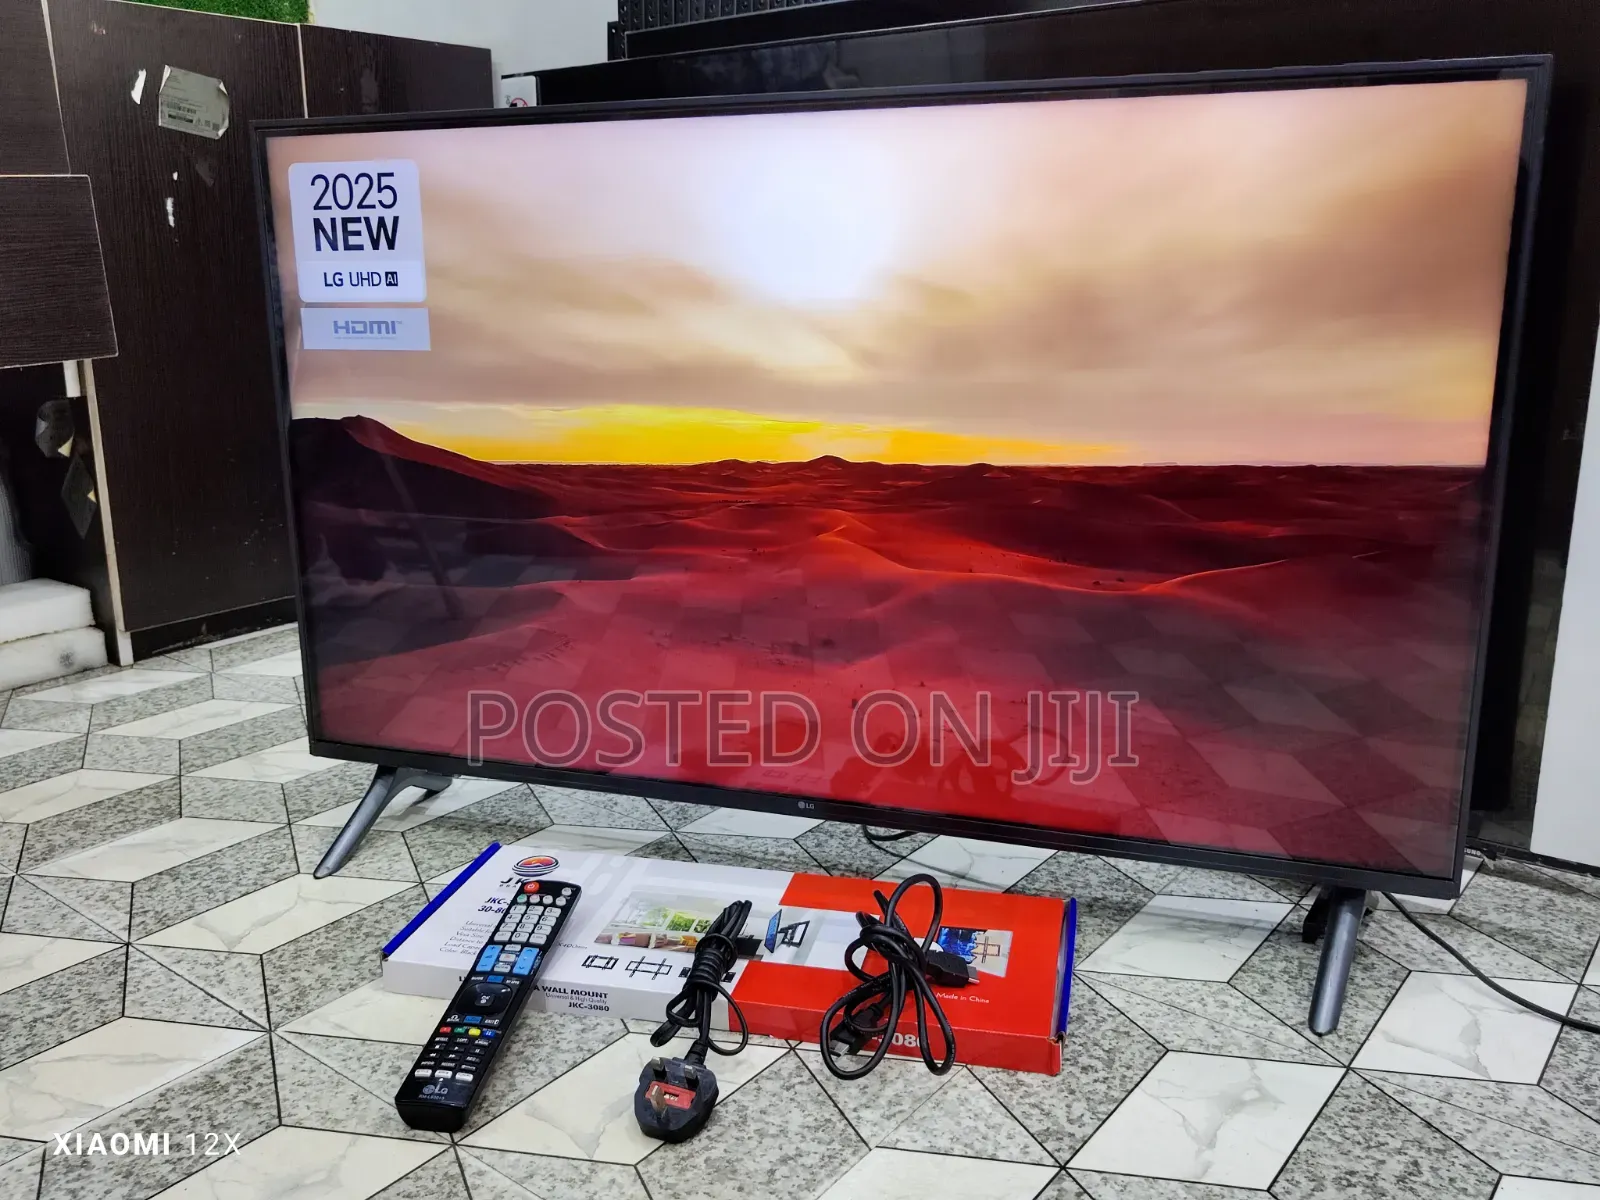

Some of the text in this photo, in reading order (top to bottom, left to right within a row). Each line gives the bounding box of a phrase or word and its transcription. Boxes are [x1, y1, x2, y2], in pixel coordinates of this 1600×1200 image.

[311, 172, 398, 211] 2025
[313, 216, 399, 251] NEW
[323, 272, 398, 287] LG UHD AI
[333, 320, 397, 335] HDMI
[541, 985, 569, 995] WALL
[570, 988, 609, 999] MOUNT
[545, 992, 570, 1000] Universal
[936, 992, 959, 1000] Made
[969, 995, 990, 1004] China
[568, 1001, 610, 1012] JKC-3080
